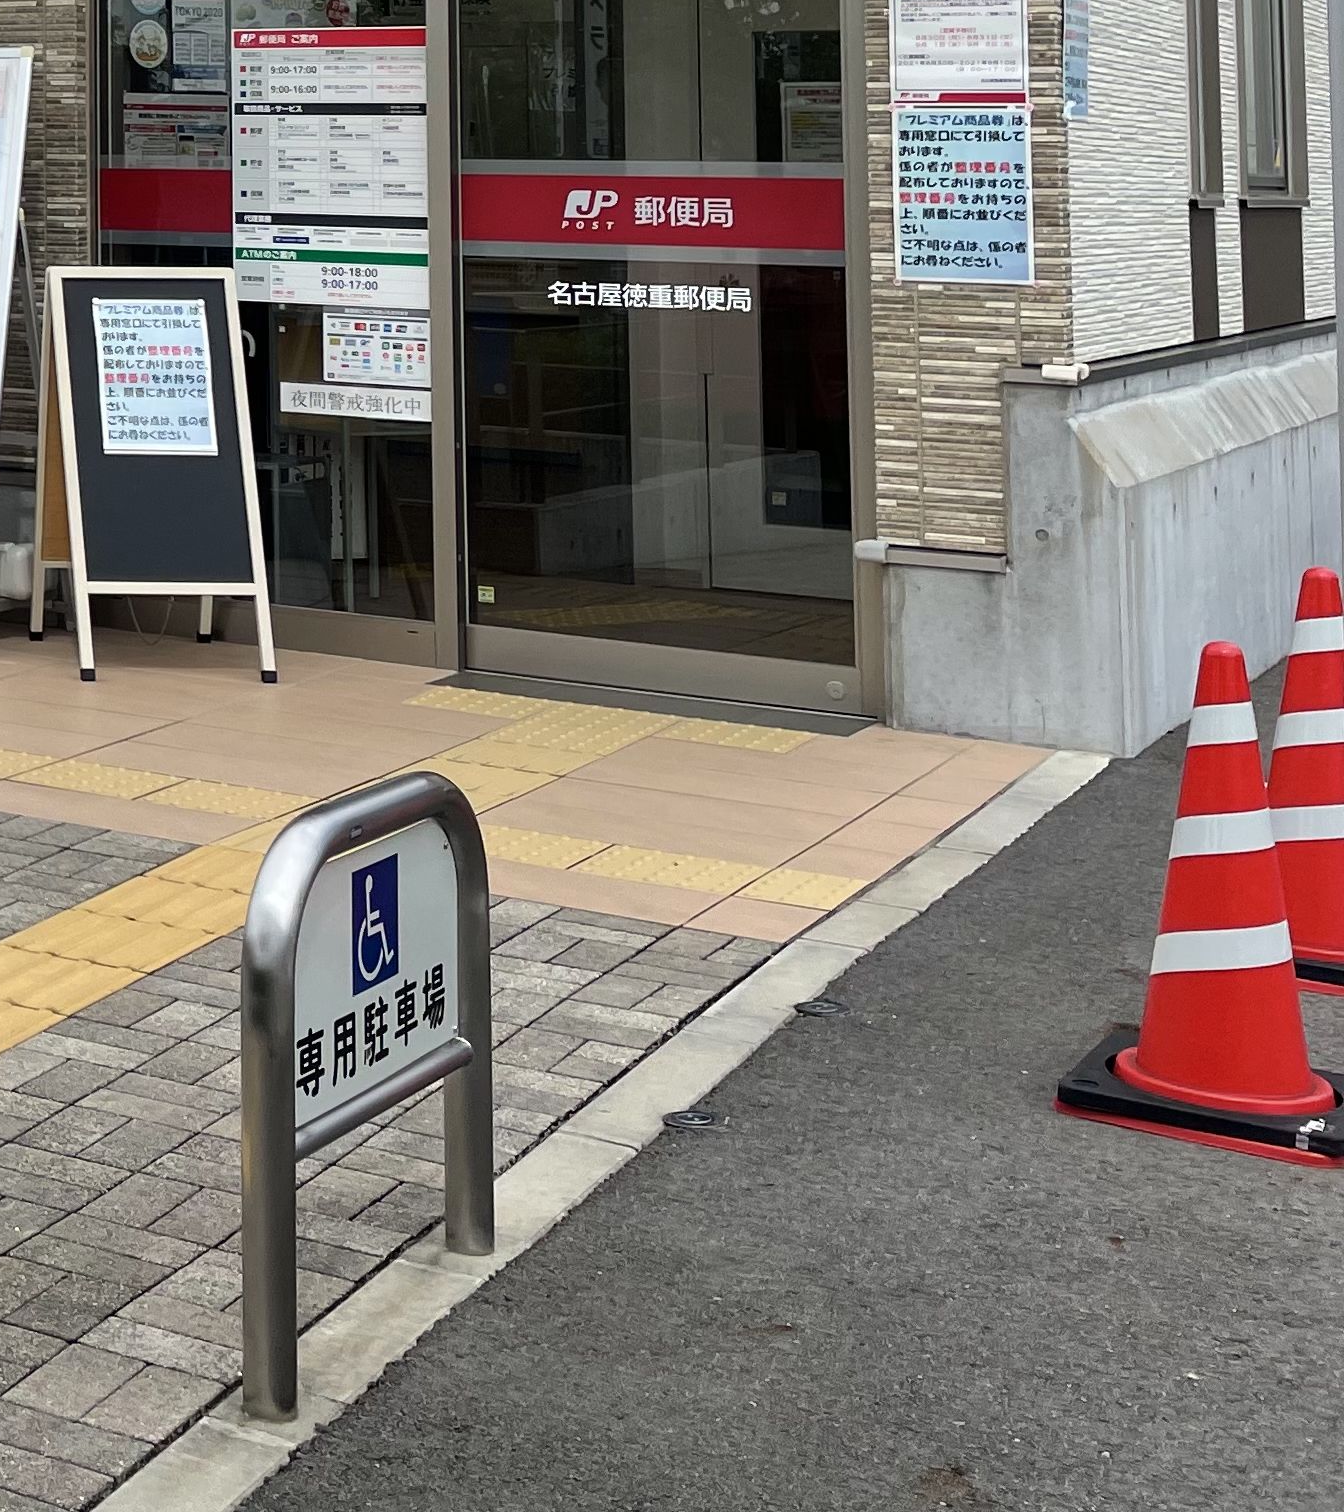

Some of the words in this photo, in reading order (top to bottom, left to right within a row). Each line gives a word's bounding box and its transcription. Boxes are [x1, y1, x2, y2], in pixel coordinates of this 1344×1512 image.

[175, 6, 202, 17] TOKYO
[259, 34, 286, 45] 郵便局
[290, 34, 318, 44] ご案内
[270, 65, 317, 74] 9:00-17:00
[270, 85, 317, 94] 9:00-16:00
[899, 130, 1025, 142] 専用窓口にて引換して
[899, 146, 949, 157] おります。
[899, 161, 1026, 174] 係の者が整理番号を
[899, 177, 1029, 190] 配布しておりますので、
[900, 192, 1027, 205] 整理番号をお持ちの
[634, 196, 734, 228] 郵便局
[561, 220, 615, 230] POST
[900, 224, 929, 235] さい。
[901, 240, 1027, 253] ご不明な点は、係の者
[241, 249, 297, 261] ATMのご案内
[901, 255, 1003, 269] にお尋ねください。
[321, 266, 378, 278] 9:00-18:00
[321, 279, 378, 291] 9:00-17:00
[547, 280, 752, 313] 名古屋徳重郵便局
[291, 391, 421, 415] 夜間警戒強化中
[296, 963, 446, 1097] 専用駐車場
